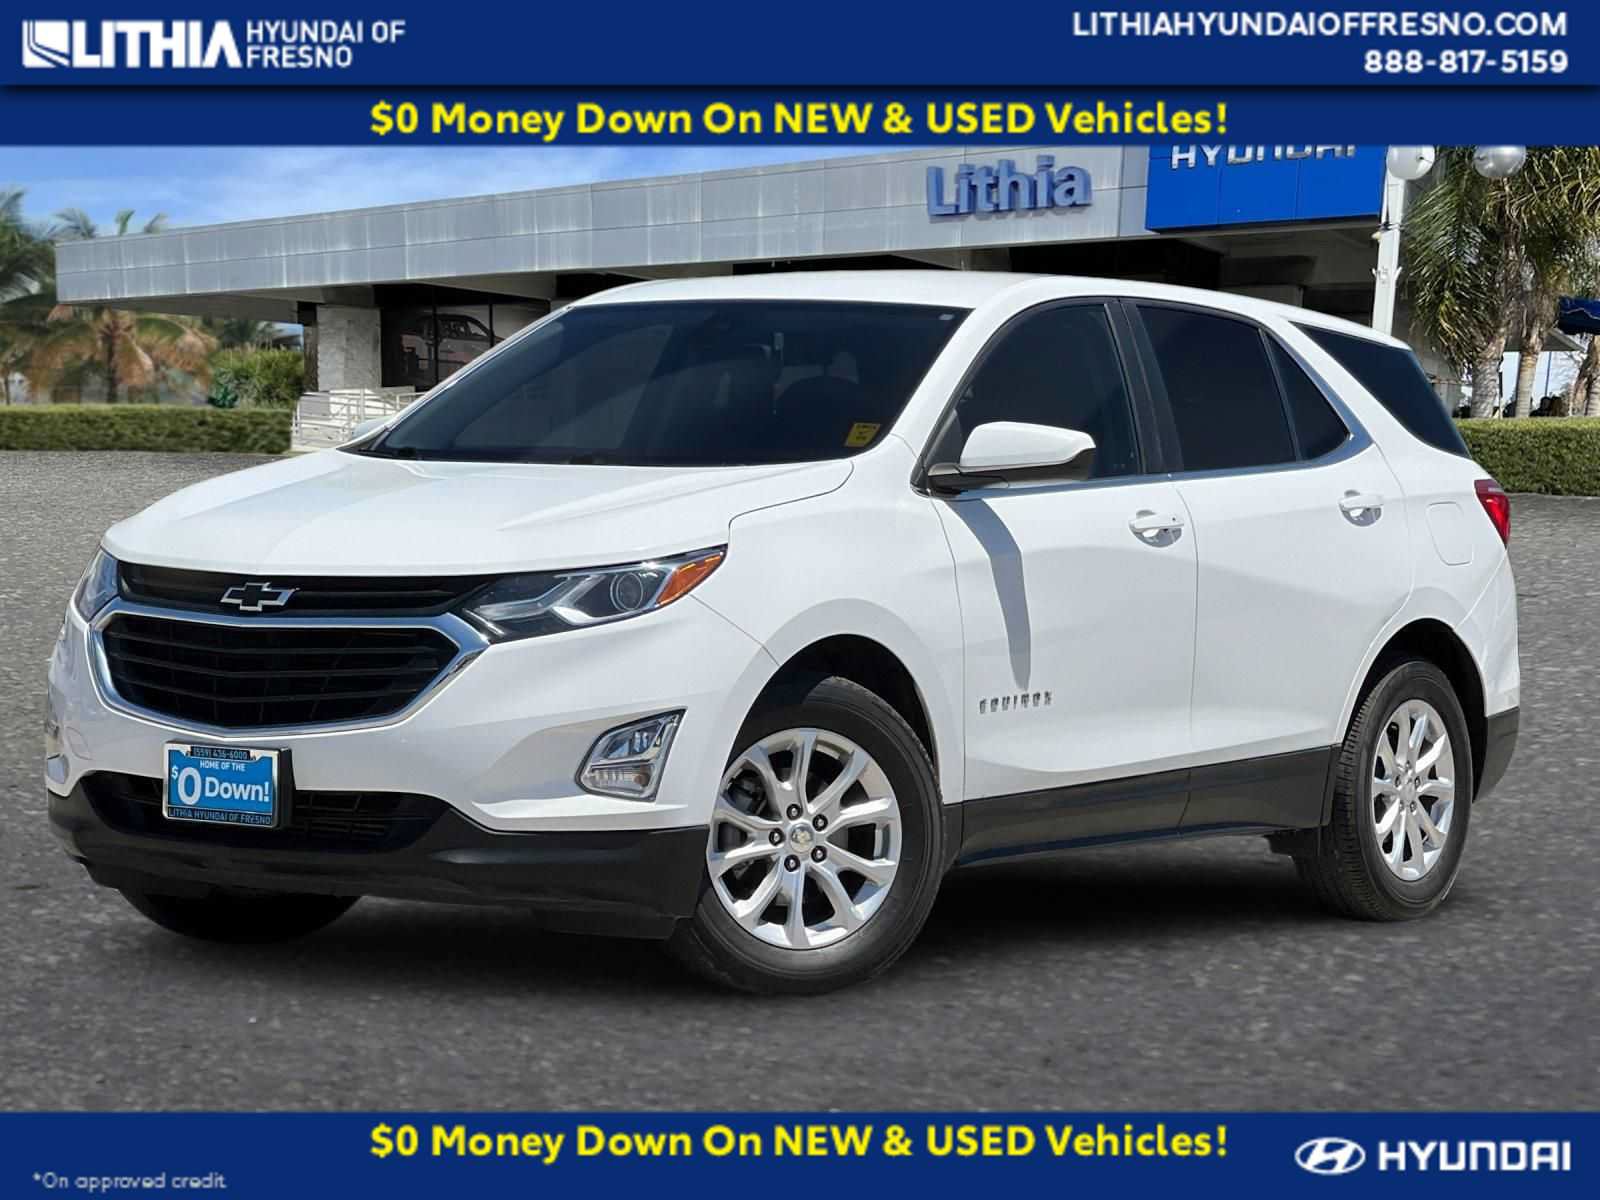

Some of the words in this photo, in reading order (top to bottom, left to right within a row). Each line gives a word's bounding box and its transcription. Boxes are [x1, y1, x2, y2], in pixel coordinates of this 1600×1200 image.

[927, 154, 1092, 216] Lithia
[979, 691, 1052, 715] EQUINOX
[200, 760, 219, 769] HOME
[221, 762, 230, 771] OF
[232, 763, 245, 772] THE
[204, 776, 270, 802] Down!
[168, 807, 193, 817] LITHIA
[194, 810, 228, 820] HYUNDAI
[228, 813, 239, 822] OF
[240, 814, 272, 825] FRESNO
